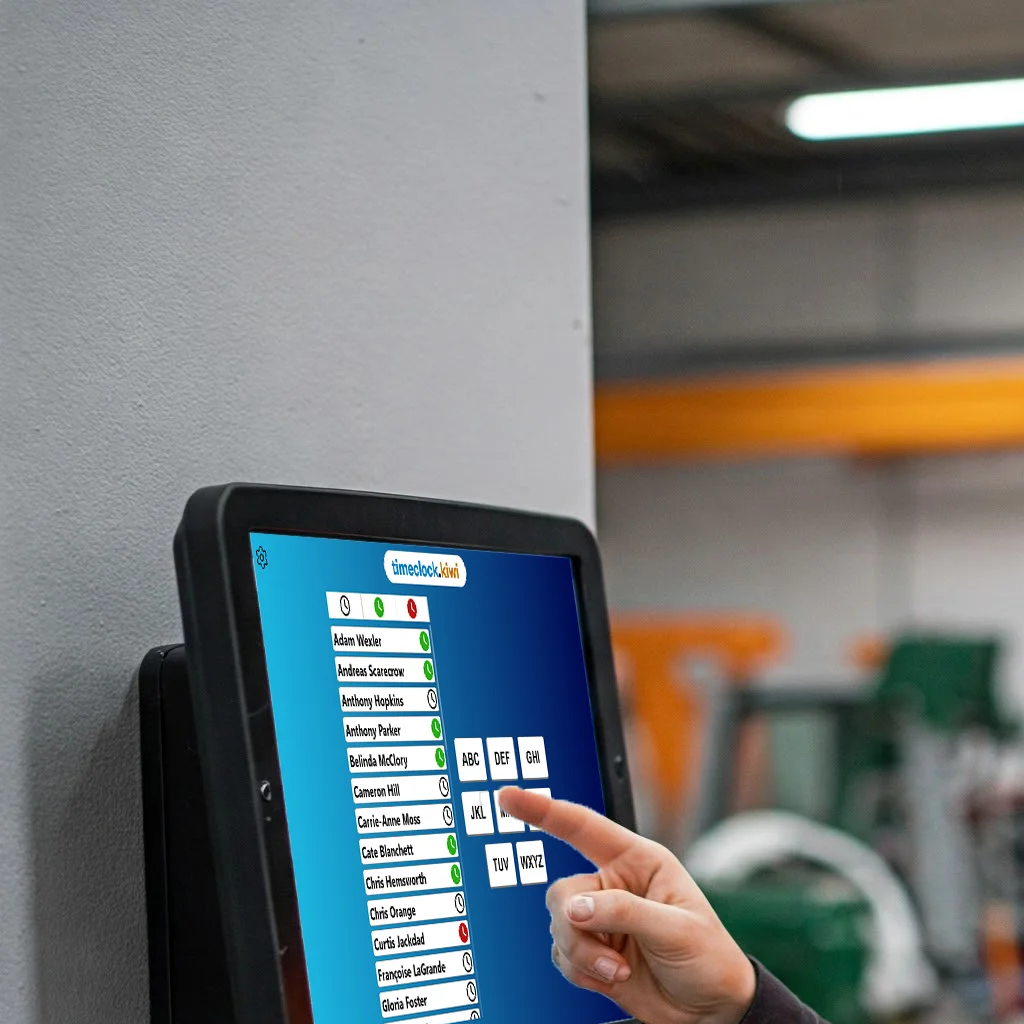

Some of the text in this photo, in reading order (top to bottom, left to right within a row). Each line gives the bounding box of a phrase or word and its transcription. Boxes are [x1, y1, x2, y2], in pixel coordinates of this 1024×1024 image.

[392, 558, 459, 579] timeclock.kiwi
[334, 633, 381, 647] Adam Wexler
[338, 664, 404, 677] Andreas Scarecrow
[342, 694, 404, 710] Anthony Hopkins
[346, 724, 401, 740] Anthony Parker
[350, 754, 407, 769] Belinda McClory
[462, 752, 480, 766] ABC
[494, 751, 510, 765] DEF
[526, 750, 541, 764] GHI
[354, 784, 401, 798] Cameron Hill
[471, 806, 486, 819] JKL
[358, 814, 420, 828] Carrie-Anne Moss
[361, 843, 414, 859] Cate Blanchett
[493, 857, 509, 872] TUV
[520, 855, 544, 869] WXYZ
[366, 873, 427, 890] Chris Hemsworth
[370, 906, 416, 921] Chris Orange
[374, 932, 425, 951] Curtis Jackdad
[378, 961, 446, 983] Françoise LaGrande
[382, 996, 428, 1012] Gloria Foster
